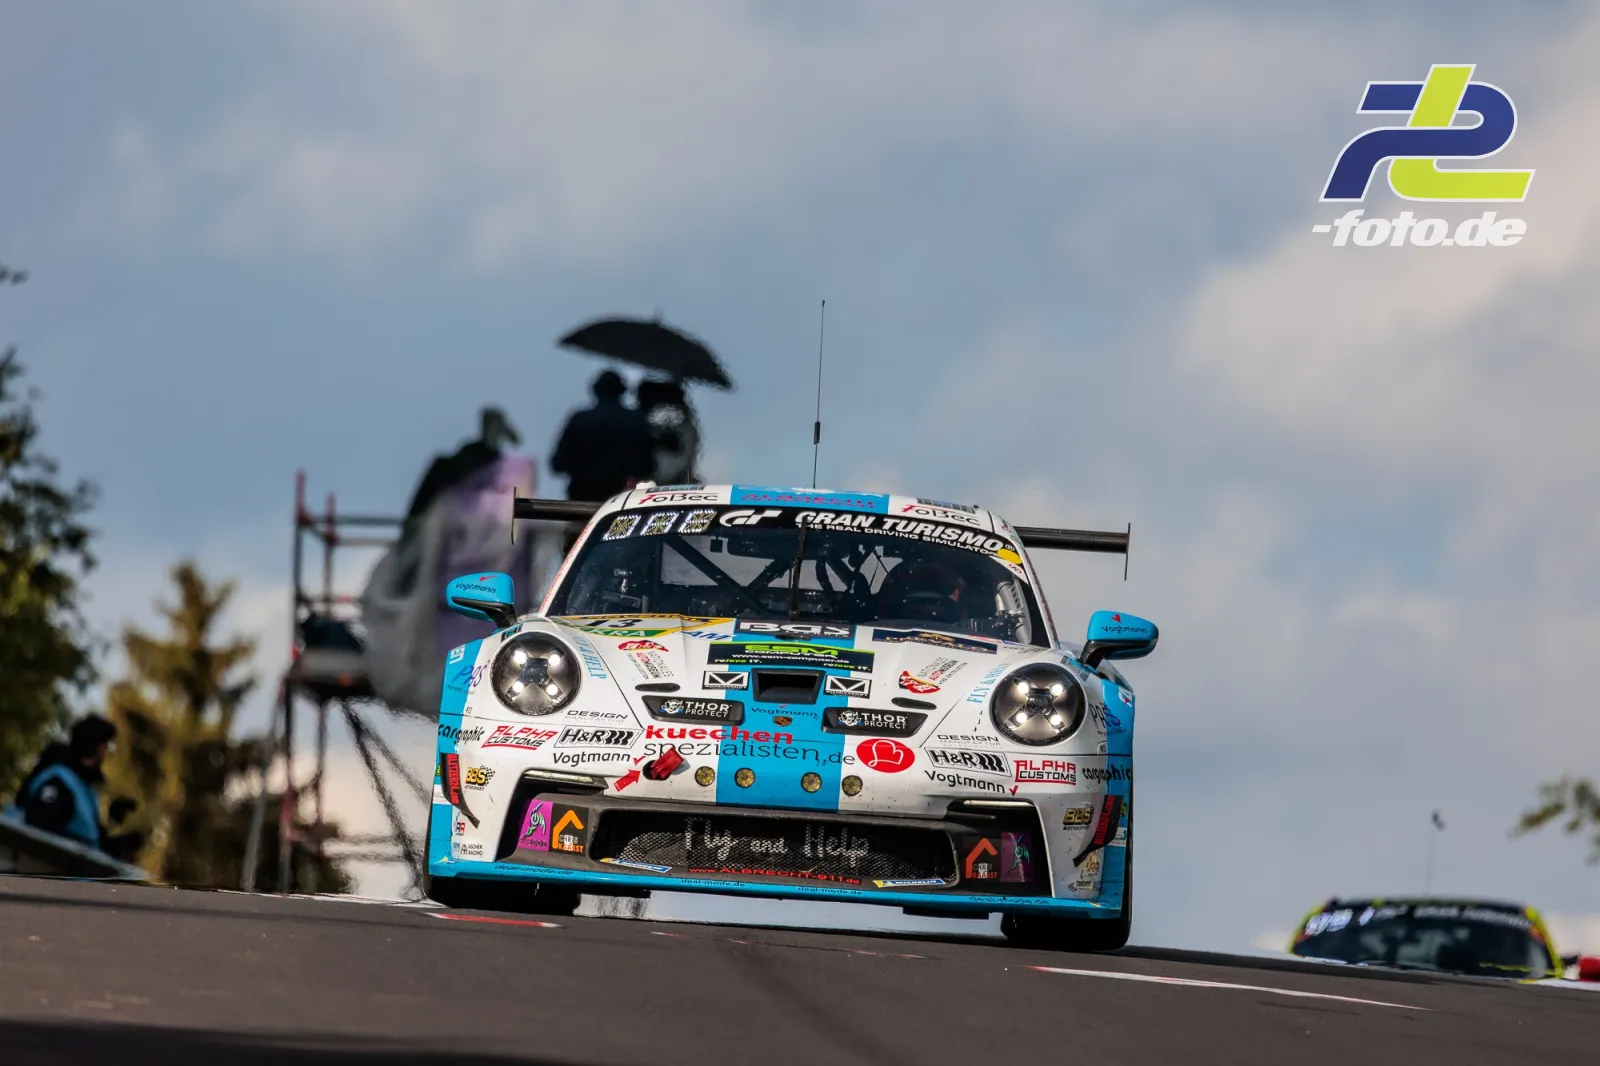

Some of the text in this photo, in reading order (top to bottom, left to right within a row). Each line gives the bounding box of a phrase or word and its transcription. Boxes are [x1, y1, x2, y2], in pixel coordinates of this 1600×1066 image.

[794, 511, 876, 528] GRAN
[882, 518, 1003, 552] TURISMO
[826, 525, 861, 533] REAL
[864, 528, 919, 540] DRIVING
[455, 582, 497, 594] Vogtmann
[586, 619, 643, 628] 13
[1100, 625, 1148, 634] Vogtmann
[966, 686, 990, 704] FLY
[685, 701, 728, 711] THOR
[751, 707, 818, 717] Vogtmann
[567, 710, 628, 719] DESIGN
[685, 709, 728, 717] PROTECT
[861, 712, 906, 723] THOR
[864, 720, 907, 729] PROTECT
[496, 725, 559, 740] ALPHA
[560, 729, 604, 743] H&R
[645, 725, 793, 744] kuechen
[488, 736, 547, 748] CUSTOMS
[553, 752, 631, 767] Vogtmann
[929, 750, 977, 767] H&R
[1016, 760, 1076, 774] ALPHA
[465, 767, 487, 786] BBS
[924, 770, 1005, 794] Vogtmann
[1020, 771, 1076, 783] CUSTOMS
[1063, 808, 1092, 825] BBS
[750, 838, 788, 854] and
[803, 824, 869, 868] Help
[494, 864, 573, 876] deal-mode.de
[688, 867, 862, 885] www.ALBRECHT-911.de
[681, 879, 746, 888] deal-mode.de
[798, 887, 862, 896] deal-mode.de
[969, 896, 1050, 906] deal-mode.de
